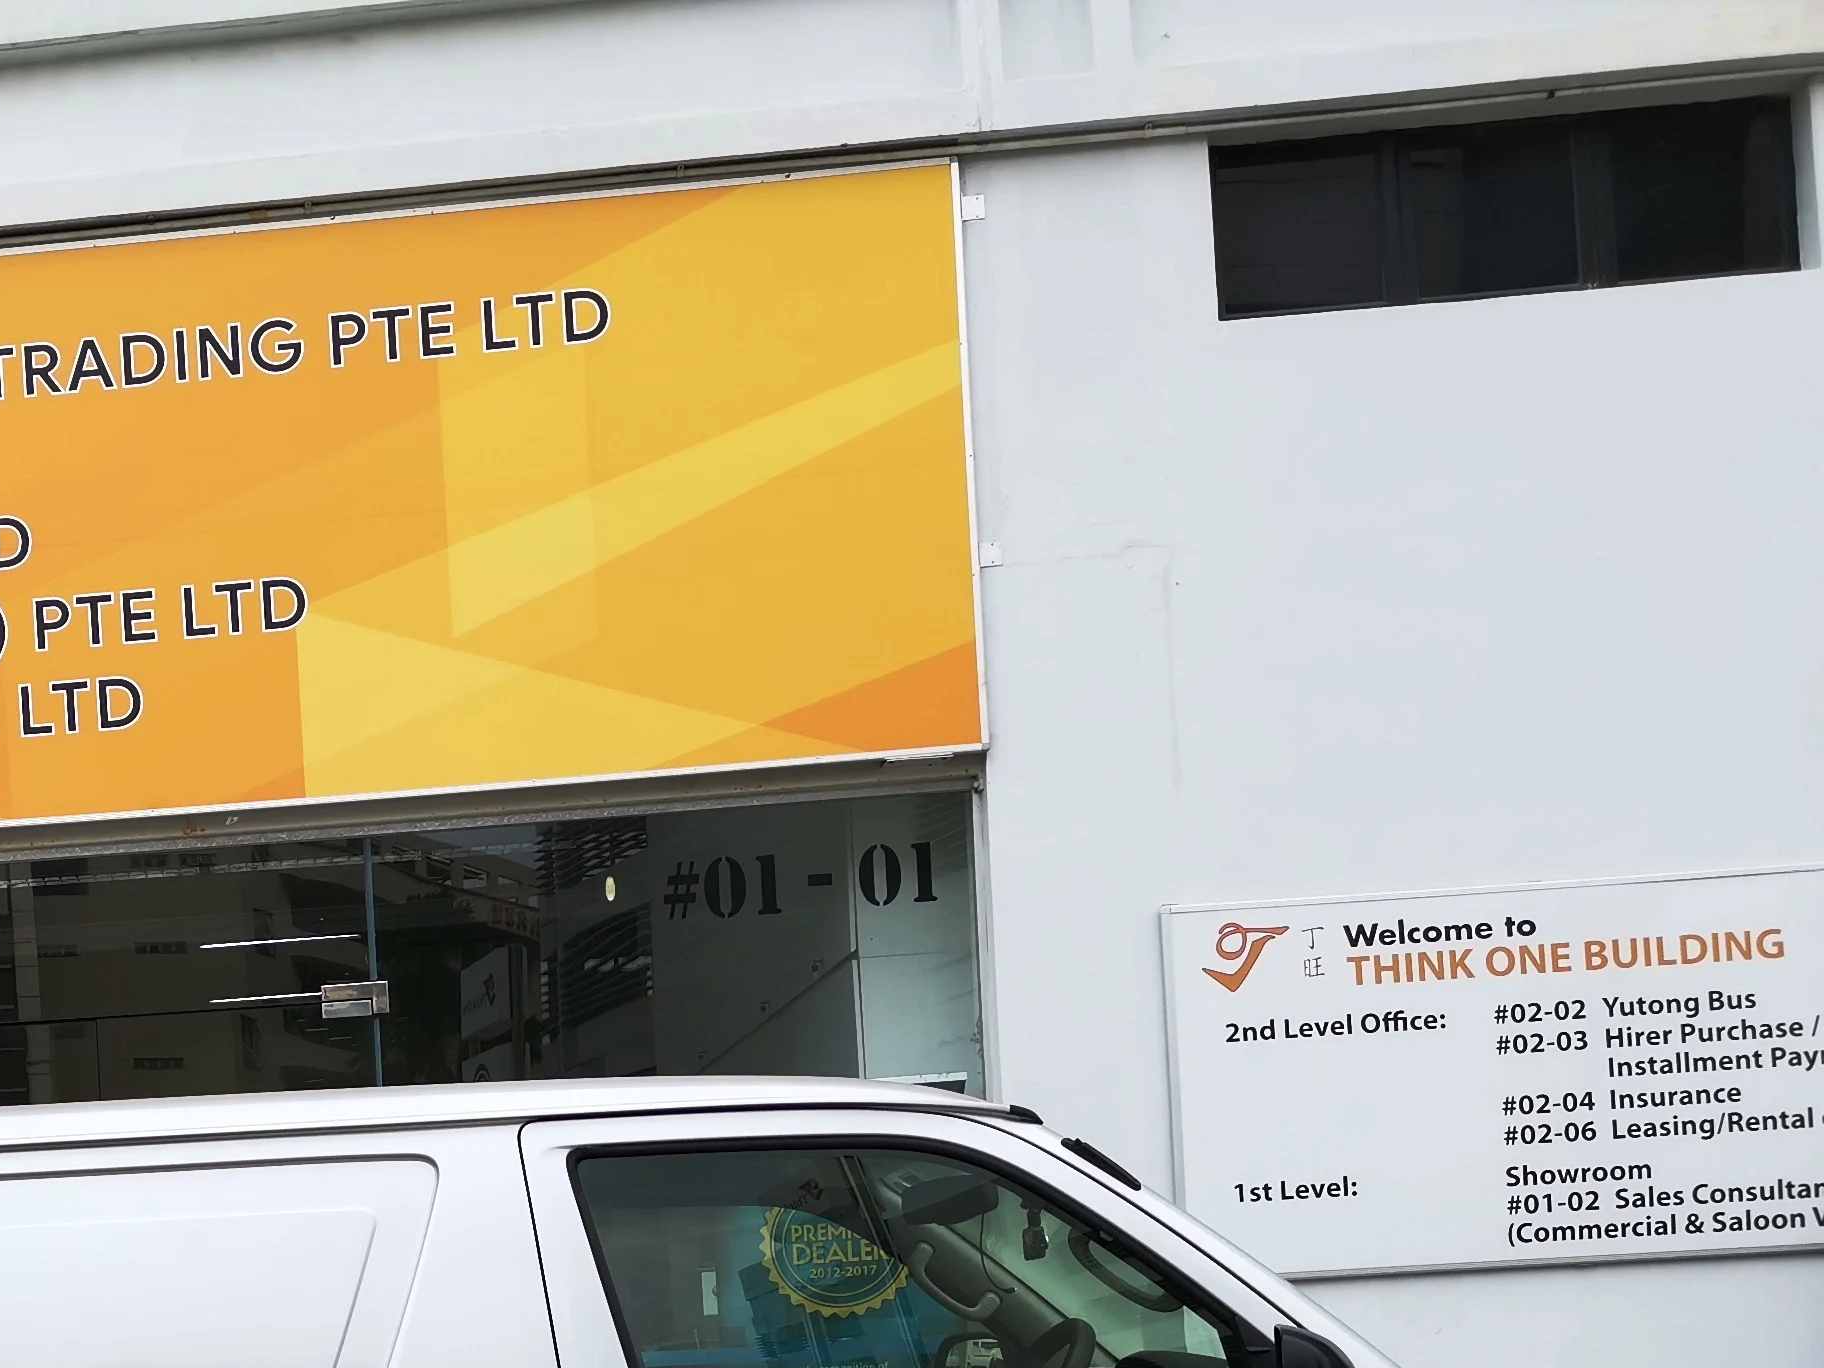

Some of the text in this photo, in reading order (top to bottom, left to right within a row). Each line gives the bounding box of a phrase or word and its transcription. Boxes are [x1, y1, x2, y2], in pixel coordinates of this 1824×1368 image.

[328, 301, 457, 368] PTE
[481, 288, 611, 353] LTD
[32, 588, 158, 652] PTE
[181, 577, 308, 639] LTD
[18, 676, 143, 738] LTD
[663, 853, 783, 921] #01
[858, 840, 940, 908] 01
[1342, 916, 1537, 948] Welcome to
[1346, 928, 1785, 986] THINK ONE BUILDING
[1493, 990, 1757, 1025] #02-02 Yutong Bus
[1225, 1009, 1447, 1043] 2nd Level Office:
[1495, 1014, 1820, 1056] #02-03 Hirer Purchase /
[1608, 1046, 1824, 1078] Installment Pay
[1501, 1087, 1742, 1116] #02-04 Insurance
[1503, 1106, 1814, 1146] #02-06 Leasing/Rental
[1233, 1175, 1358, 1203] 1st Level:
[1505, 1163, 1652, 1187] Showroom
[1506, 1190, 1600, 1216] #01-02
[1615, 1185, 1685, 1210] Sales
[790, 1222, 863, 1242] PREMI
[1507, 1213, 1677, 1248] (Commercial
[1684, 1212, 1705, 1235] &
[1712, 1209, 1806, 1233] Saloon
[809, 1264, 877, 1279] 2012-2017
